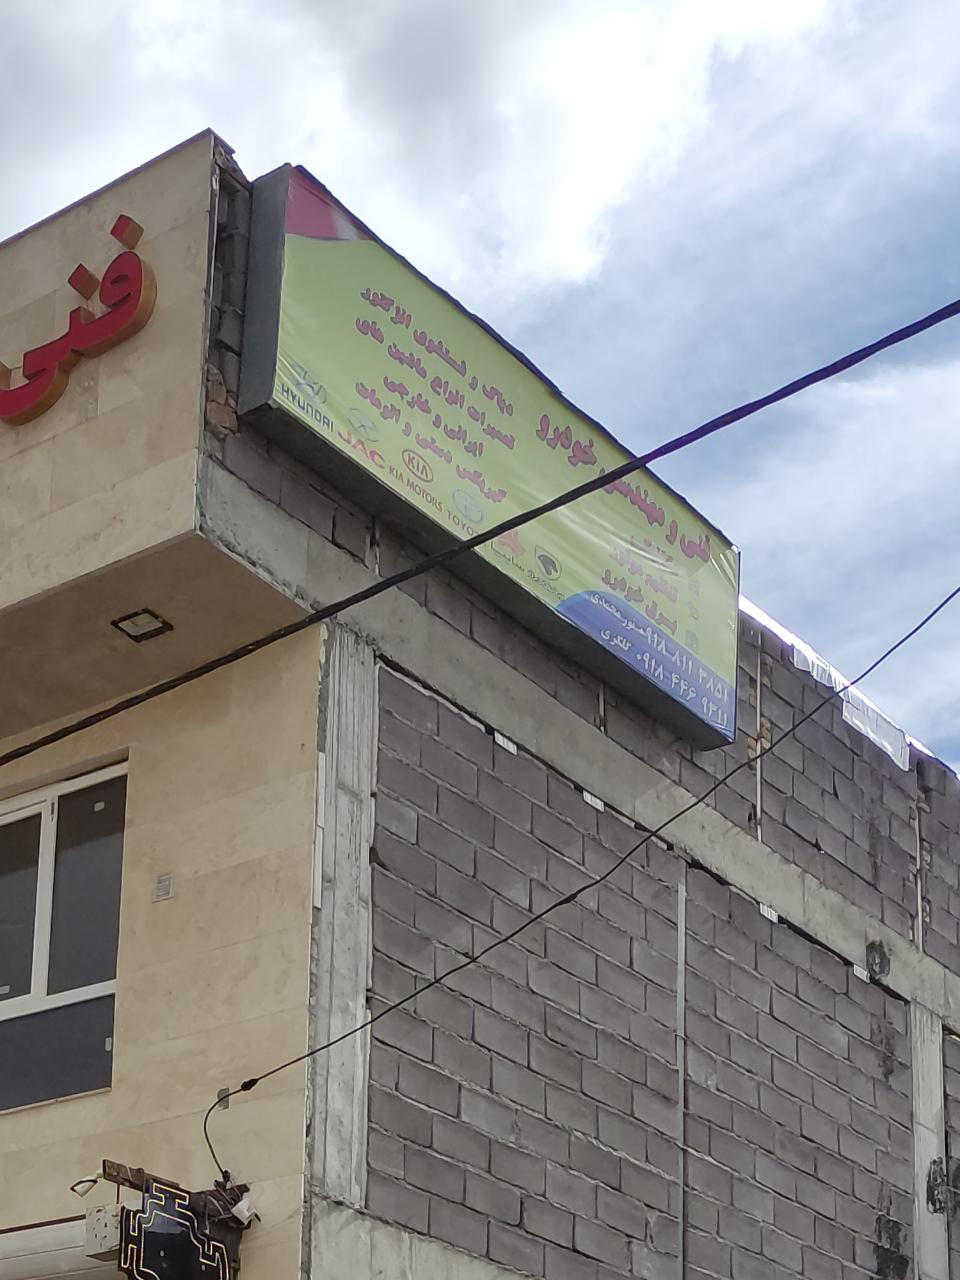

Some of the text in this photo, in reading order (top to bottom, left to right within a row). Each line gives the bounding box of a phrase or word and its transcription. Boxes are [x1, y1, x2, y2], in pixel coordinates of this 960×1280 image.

[355, 317, 385, 344] های
[430, 375, 465, 409] انواع
[468, 375, 479, 392] و
[280, 383, 335, 433] HYUNDAI
[432, 414, 442, 429] و
[336, 429, 386, 470] JAC
[535, 413, 597, 468] خودرو
[389, 463, 443, 513] KIA MOTORS
[665, 519, 678, 545] و
[679, 534, 711, 562] فنی
[698, 666, 728, 704] ۳۸۵۱
